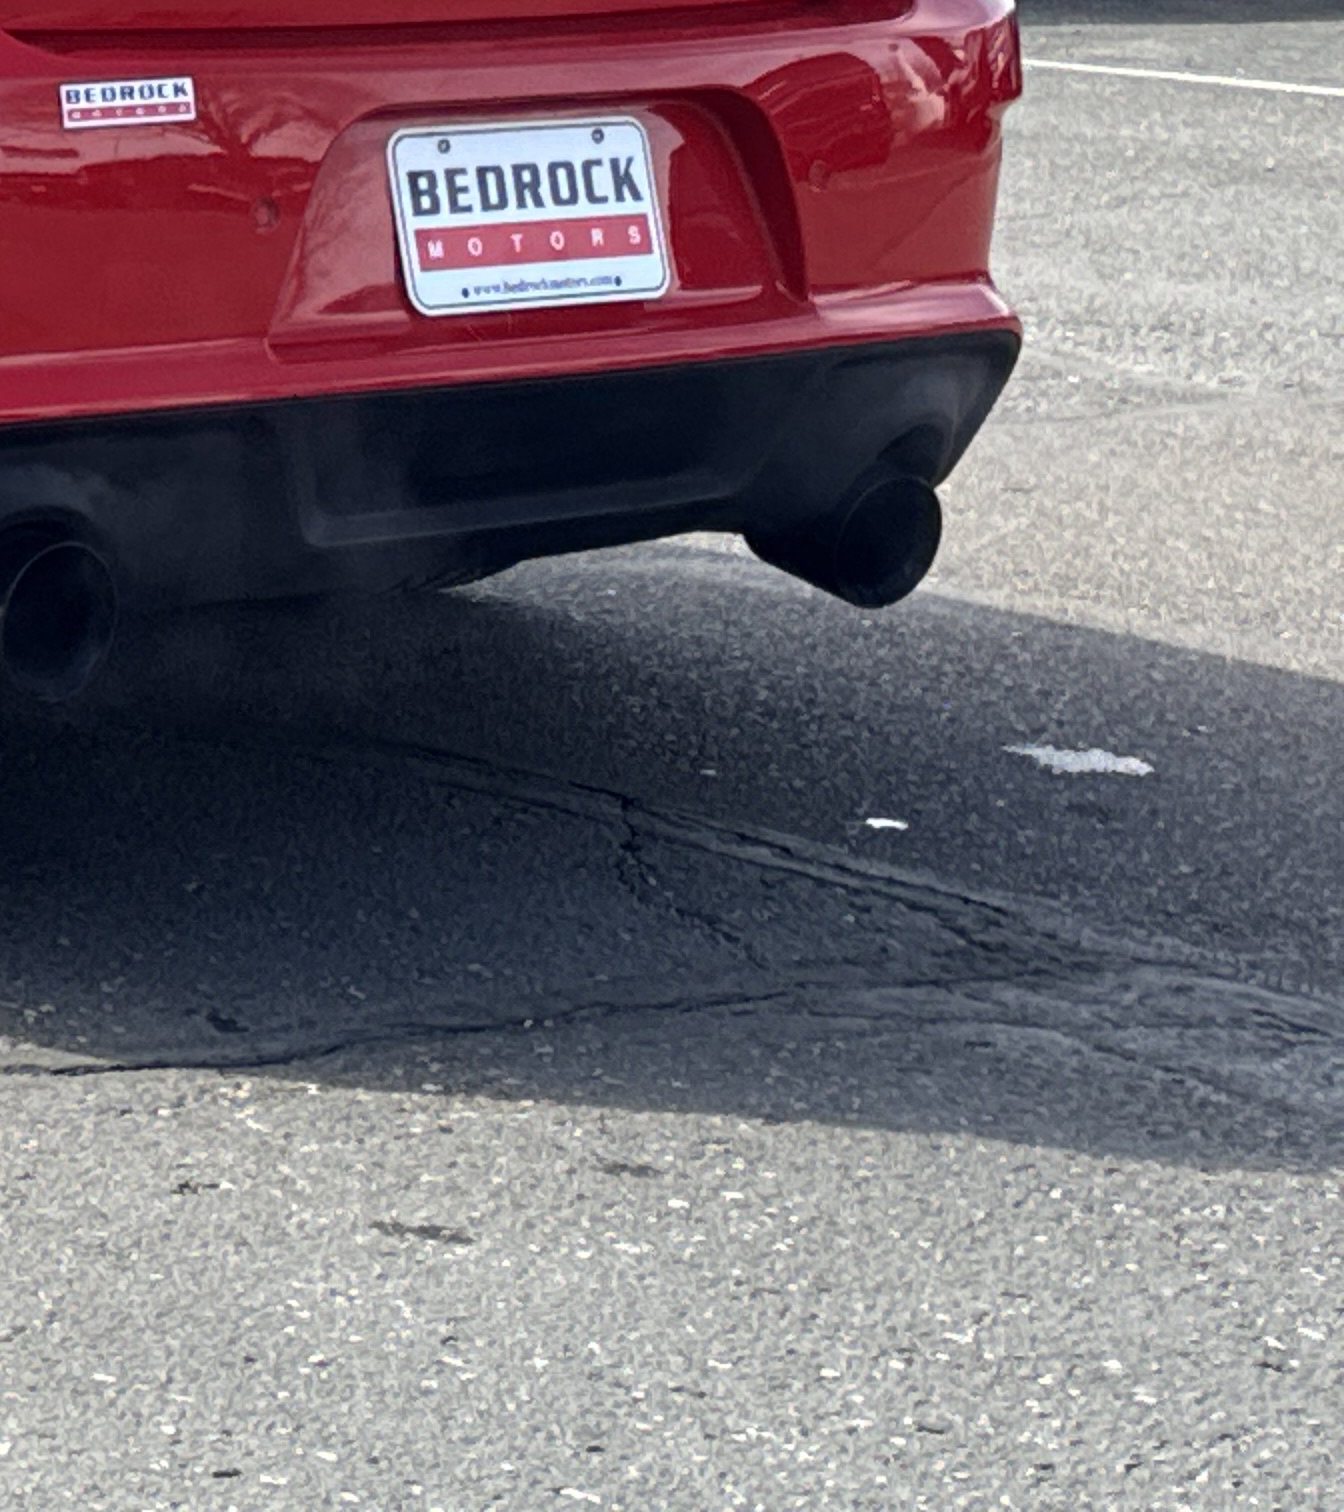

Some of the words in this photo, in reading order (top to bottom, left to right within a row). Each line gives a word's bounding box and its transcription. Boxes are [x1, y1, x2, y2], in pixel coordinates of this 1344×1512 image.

[65, 82, 189, 105] BEDROCK
[406, 155, 644, 217] BEDROCK
[427, 225, 642, 258] MOTORS
